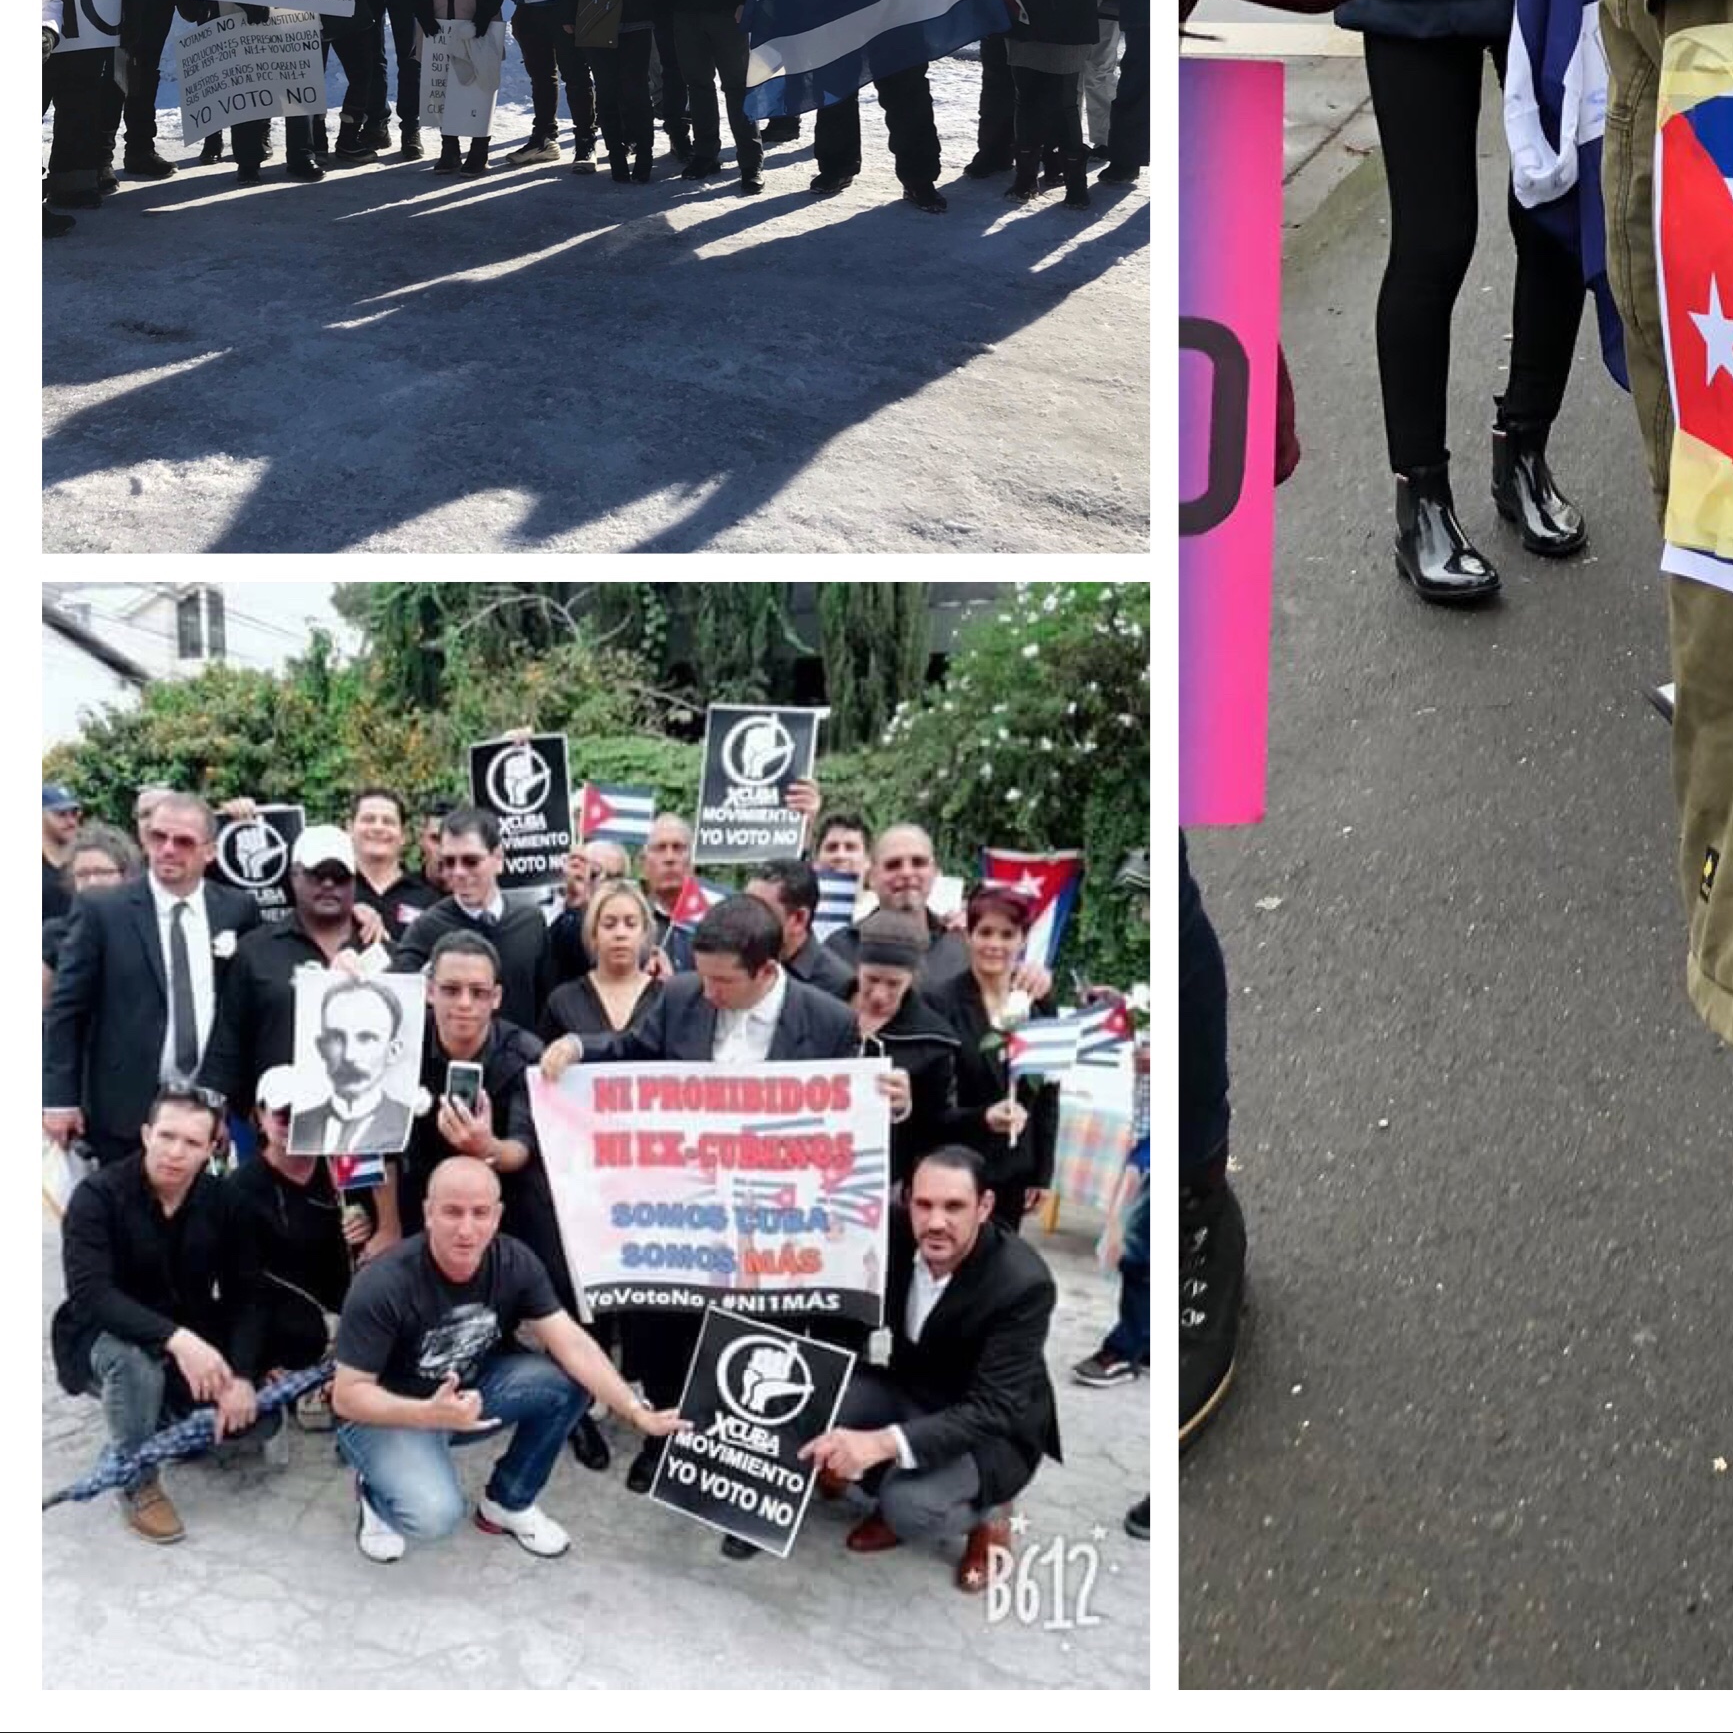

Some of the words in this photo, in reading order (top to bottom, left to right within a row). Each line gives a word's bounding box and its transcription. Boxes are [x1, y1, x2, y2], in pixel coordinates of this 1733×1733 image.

[179, 27, 213, 48] VOTAMOS
[216, 18, 236, 33] NO
[240, 34, 284, 45] REPRESION
[285, 32, 296, 44] EN
[296, 29, 319, 41] CUBA
[183, 66, 201, 78] DESDE
[268, 46, 279, 54] YO
[281, 43, 301, 53] VOTO
[302, 40, 320, 51] NO
[431, 63, 442, 72] SU
[432, 53, 444, 62] NO
[185, 74, 219, 96] NUESTROS
[256, 62, 269, 72] NO
[271, 60, 297, 71] CABEN
[299, 59, 311, 69] EN
[186, 95, 200, 106] SUS
[231, 75, 244, 87] NO
[246, 73, 253, 83] AL
[190, 106, 212, 128] YO
[218, 89, 273, 114] VOTO
[286, 86, 317, 104] NO
[700, 827, 724, 845] YO
[726, 828, 771, 845] VOTO
[773, 830, 798, 845] NO
[505, 855, 546, 874] VOTO
[592, 1077, 633, 1113] NI
[636, 1073, 850, 1114] PROHIBIDOS
[593, 1131, 633, 1167] NI
[611, 1201, 729, 1231] SOMOS
[621, 1242, 737, 1274] SOMOS
[675, 1432, 804, 1493] MOVIMIENTO
[667, 1455, 697, 1485] YO
[701, 1469, 758, 1511] VOTO
[757, 1494, 794, 1527] NO
